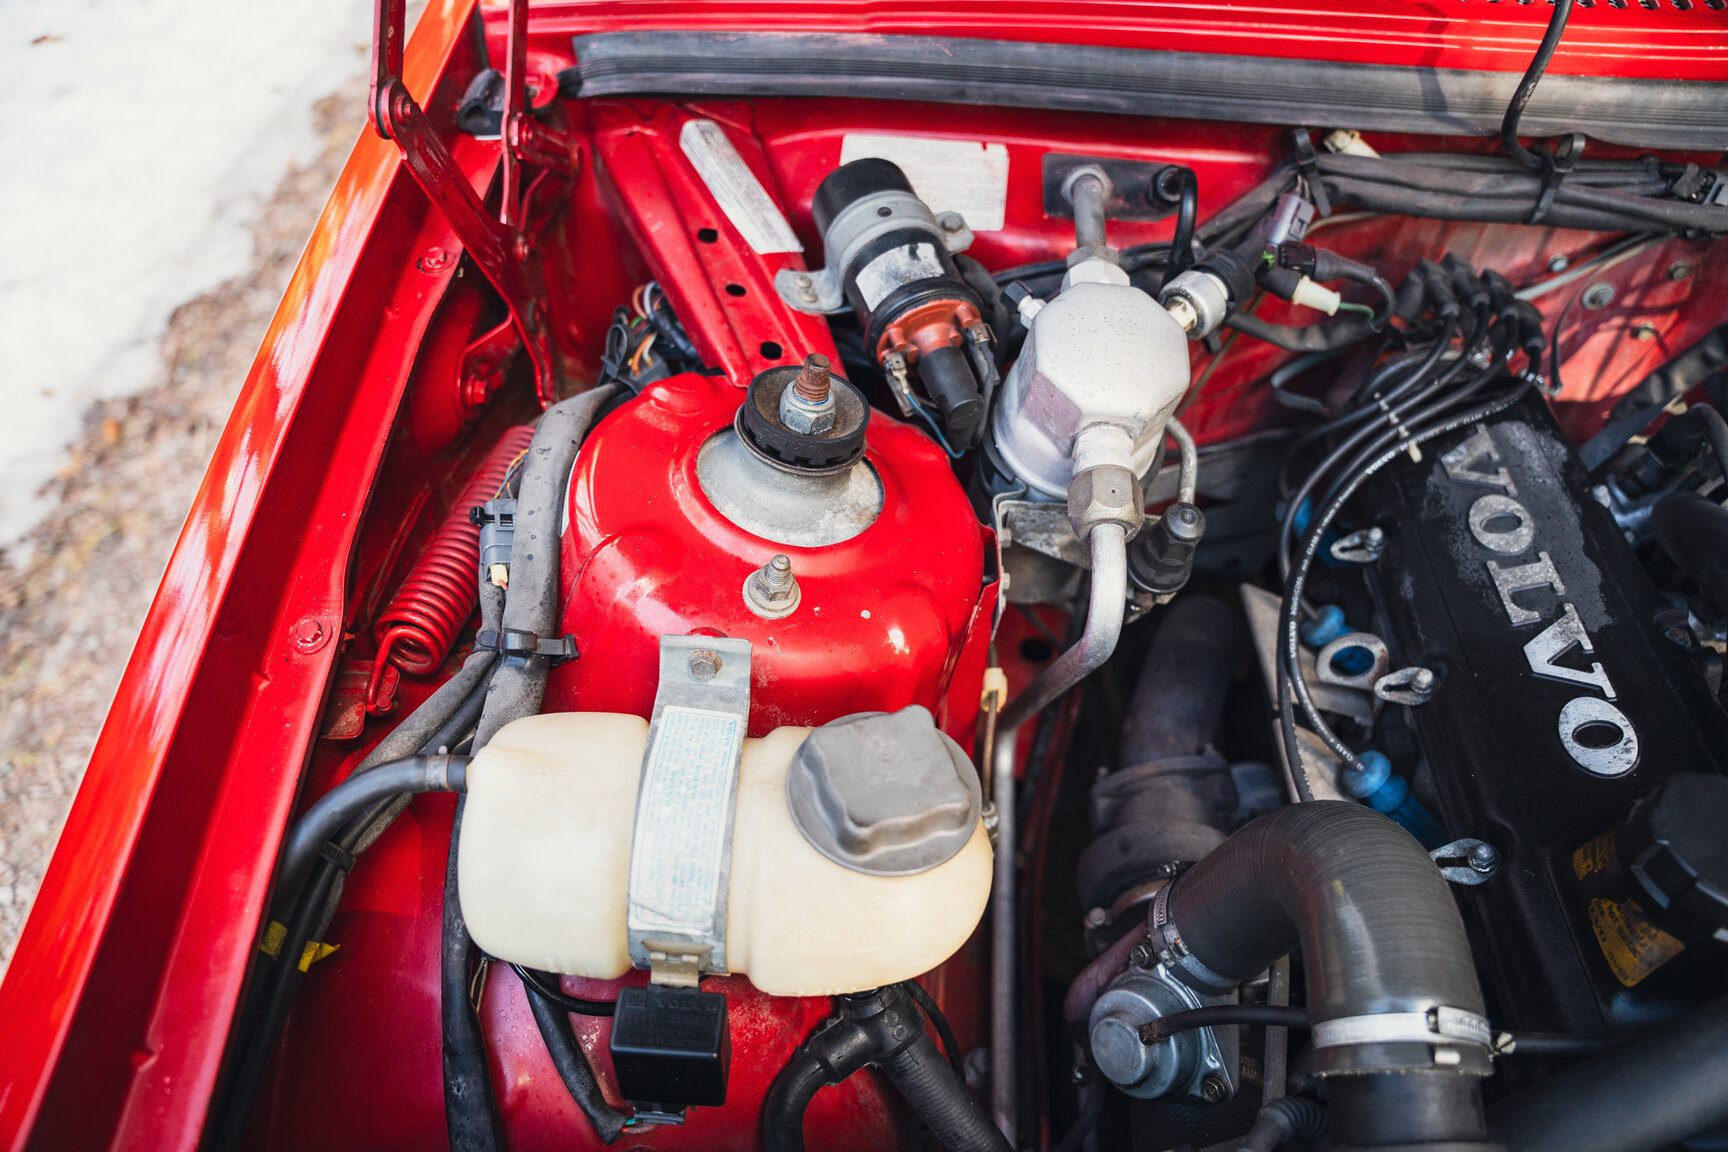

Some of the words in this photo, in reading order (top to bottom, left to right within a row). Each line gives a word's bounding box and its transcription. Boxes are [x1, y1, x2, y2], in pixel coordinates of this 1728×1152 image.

[1441, 424, 1639, 777] VOLVO
[1288, 620, 1298, 659] VOLVO
[725, 721, 735, 747] VOLVO
[665, 770, 677, 806] VOLVO
[691, 764, 702, 800] VOLVO
[796, 920, 867, 946] MAX
